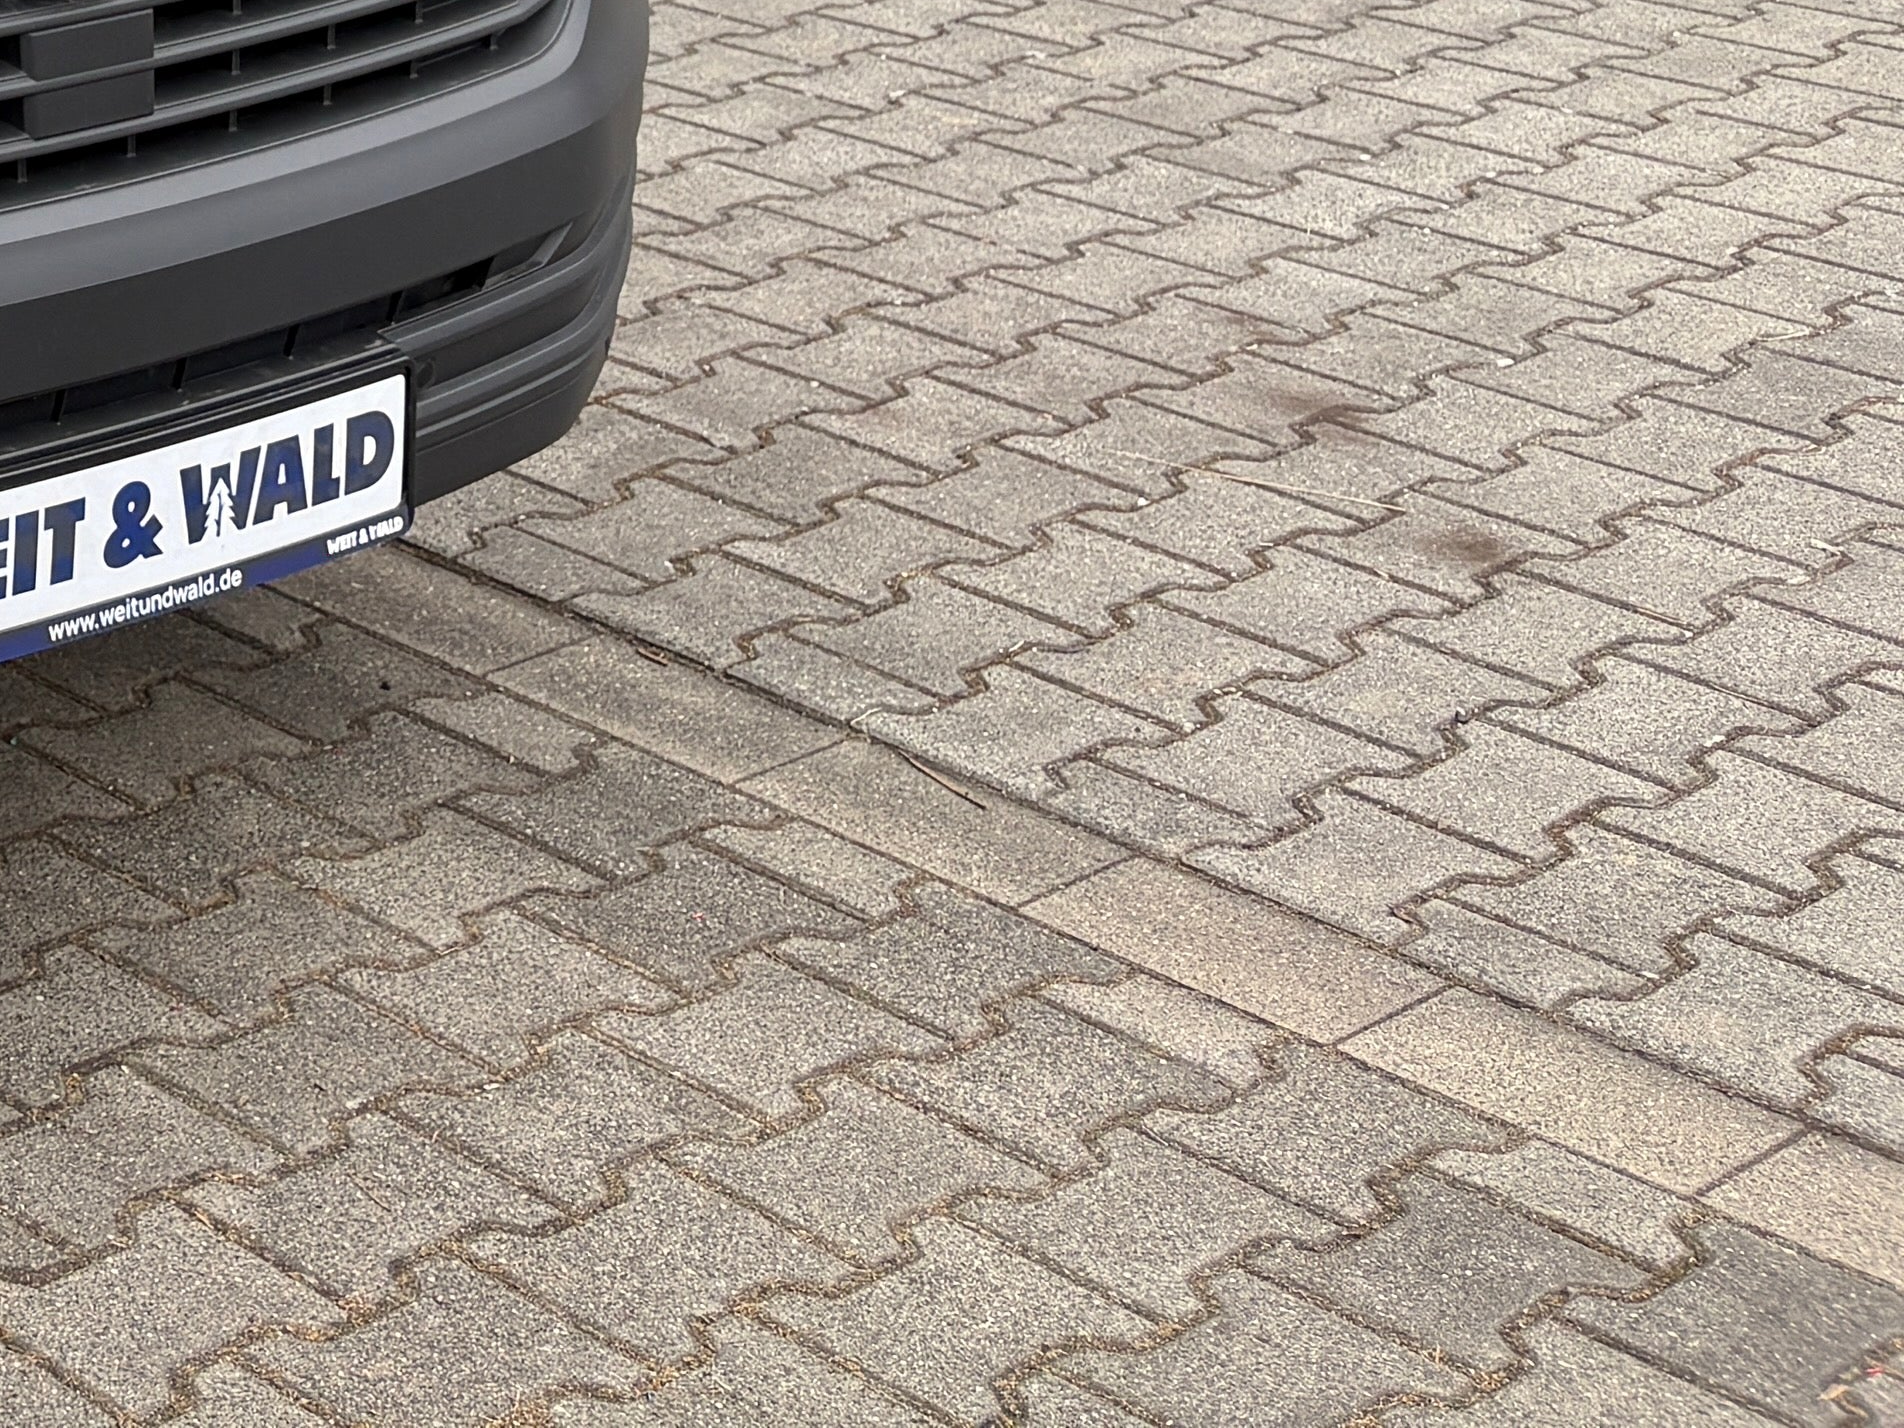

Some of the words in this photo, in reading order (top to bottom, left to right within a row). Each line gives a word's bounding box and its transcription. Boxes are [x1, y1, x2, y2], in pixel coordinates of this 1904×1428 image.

[102, 479, 164, 569] &
[179, 409, 395, 545] WALD
[326, 529, 358, 555] WEIT
[48, 568, 243, 642] www.weitundwald.de
